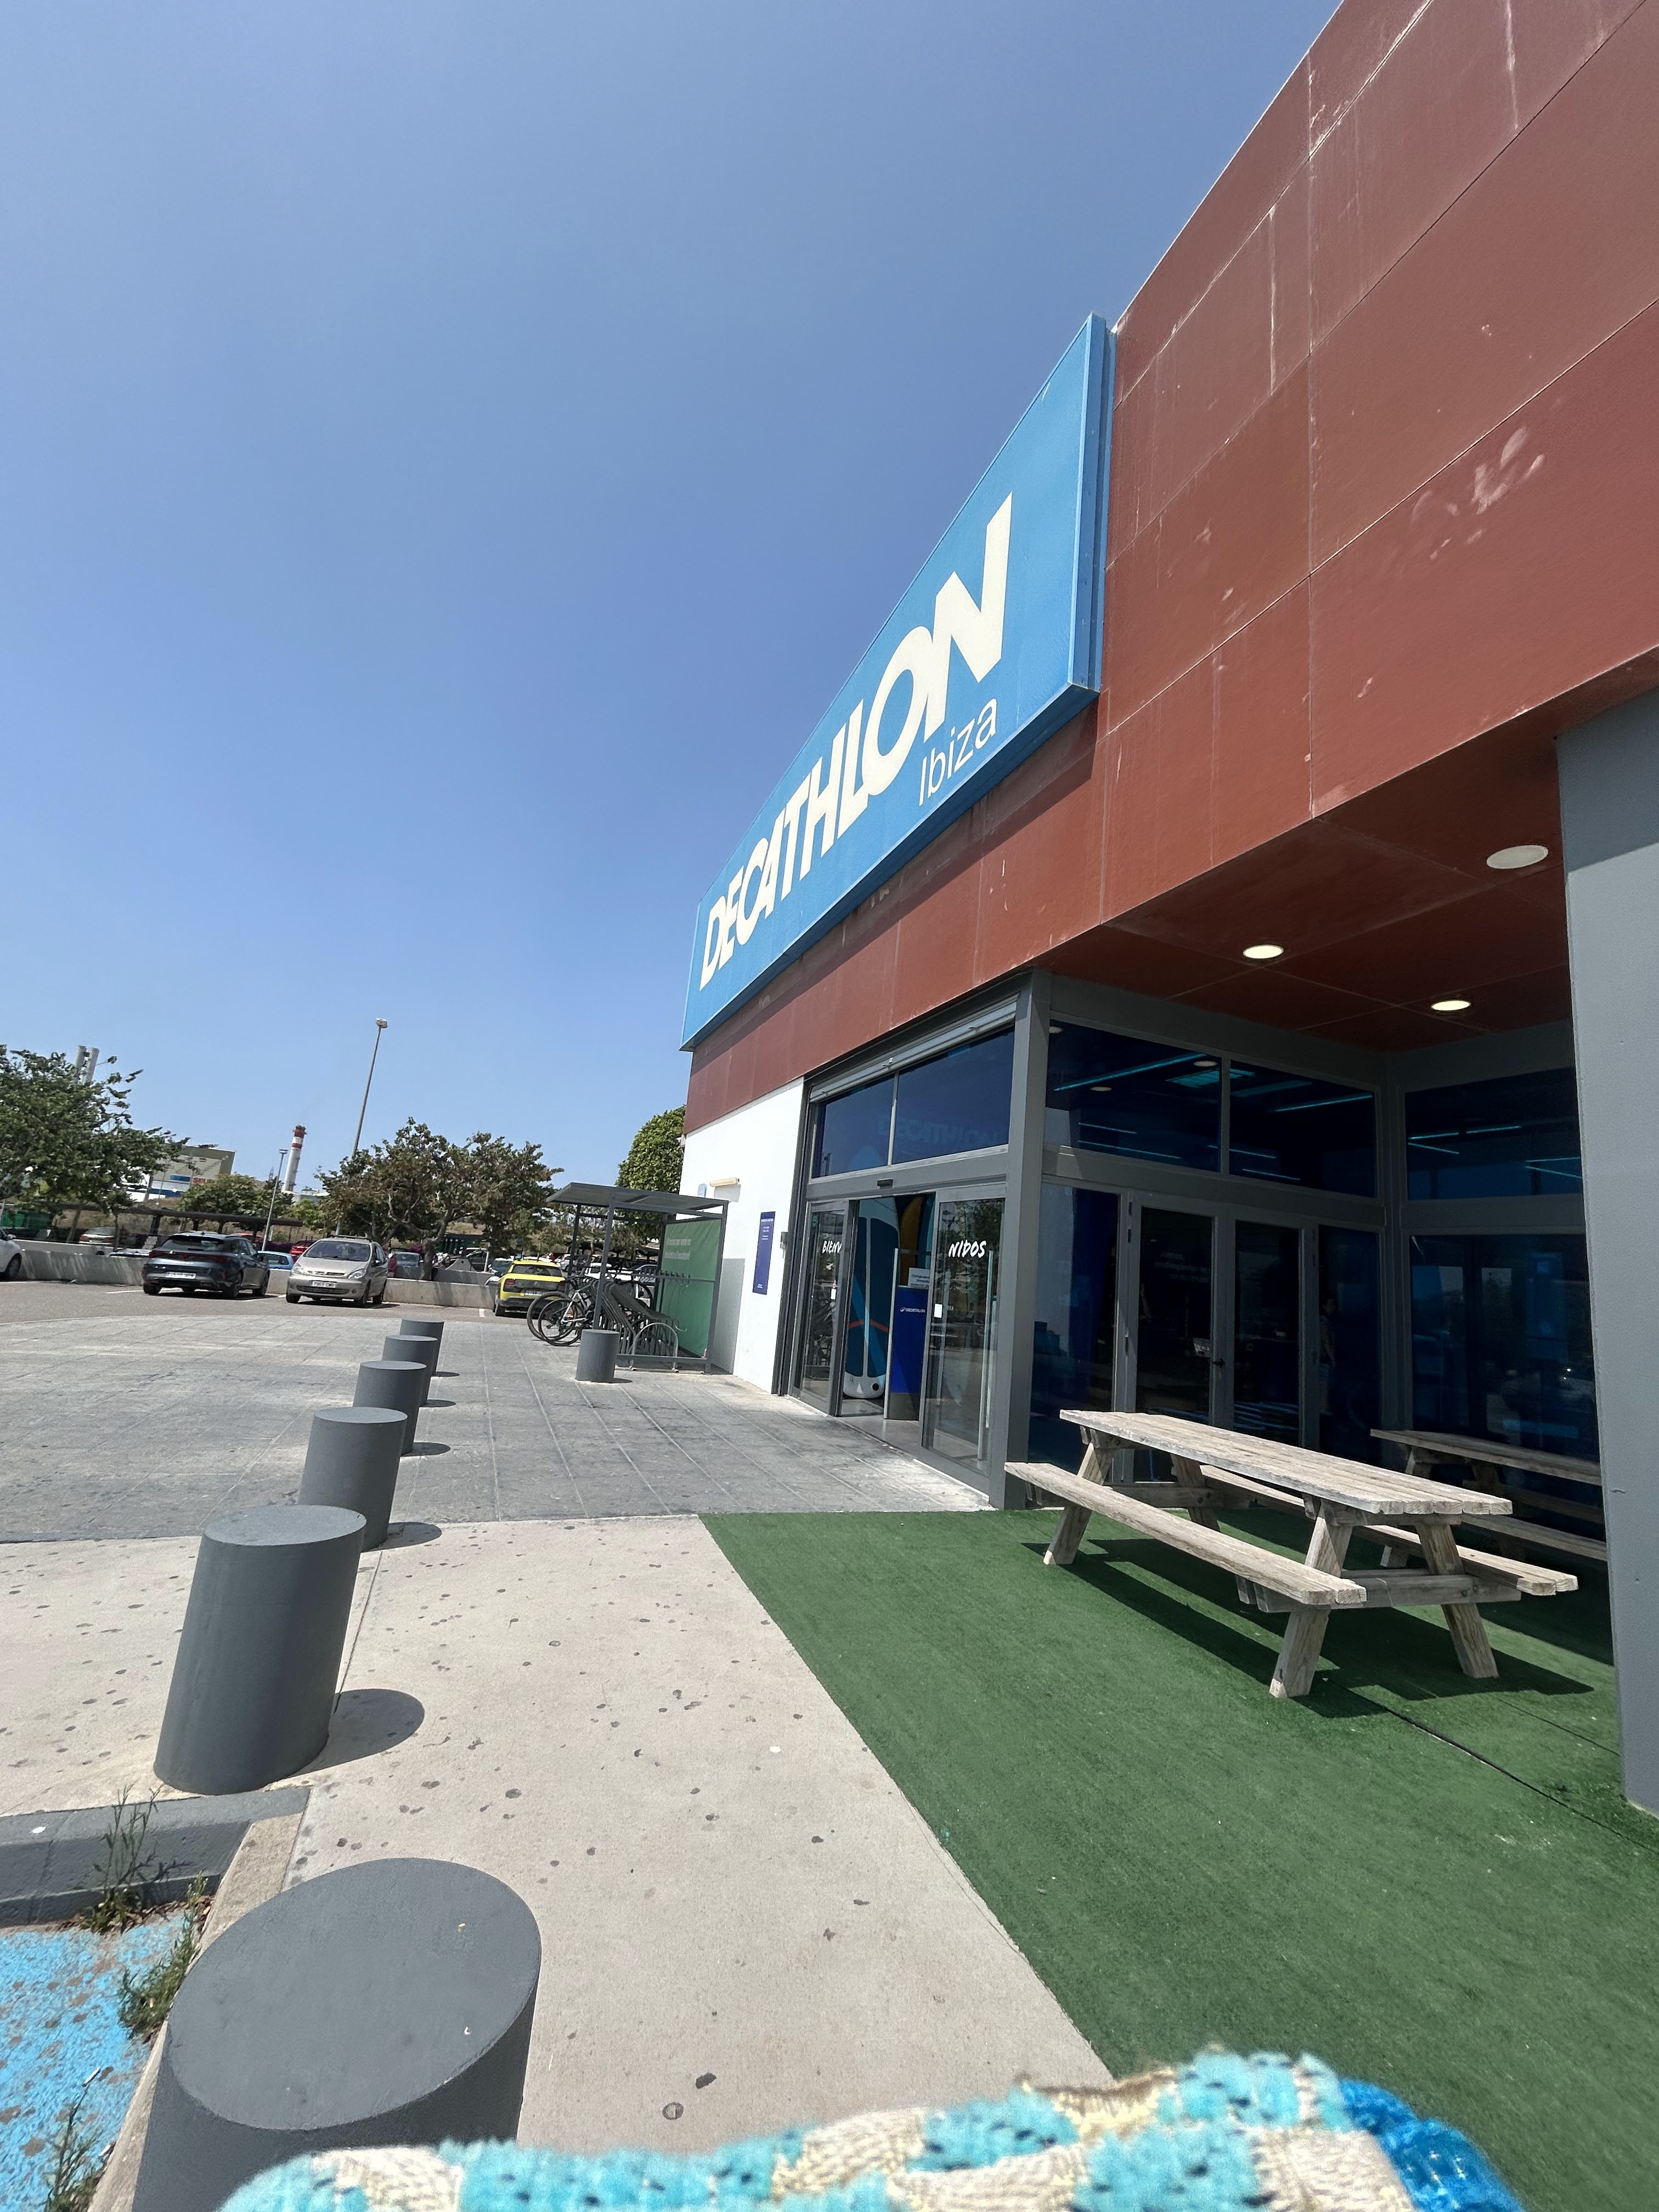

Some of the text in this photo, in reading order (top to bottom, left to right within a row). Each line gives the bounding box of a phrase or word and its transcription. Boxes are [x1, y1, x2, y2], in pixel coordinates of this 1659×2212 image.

[699, 492, 1013, 991] DECATHLON
[919, 699, 997, 806] Ibiza
[948, 1239, 987, 1258] NIDOS
